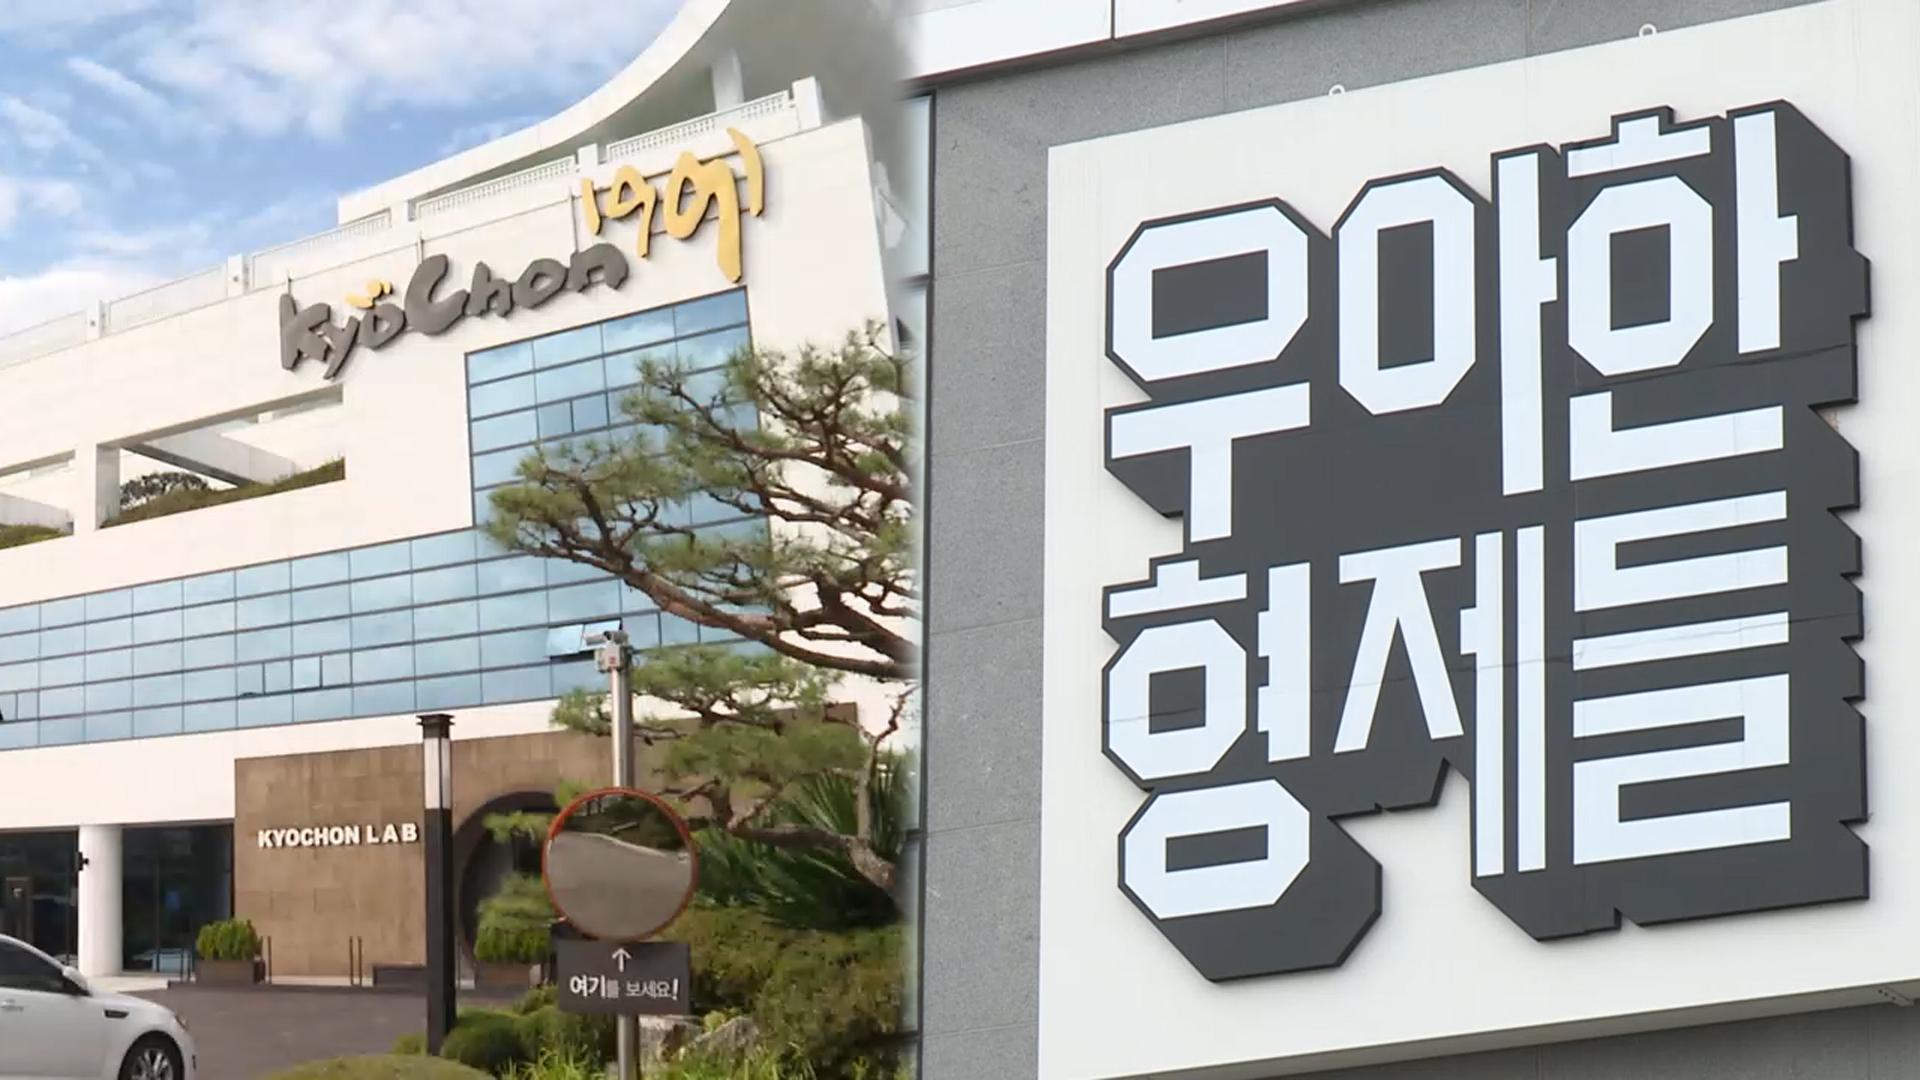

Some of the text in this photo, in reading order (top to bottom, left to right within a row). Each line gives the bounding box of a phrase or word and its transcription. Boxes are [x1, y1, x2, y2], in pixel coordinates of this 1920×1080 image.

[1111, 109, 1799, 543] 우아한
[1107, 490, 1792, 920] 형제들
[258, 823, 418, 848] KYOCHON LAB
[625, 978, 679, 1000] 보세요!
